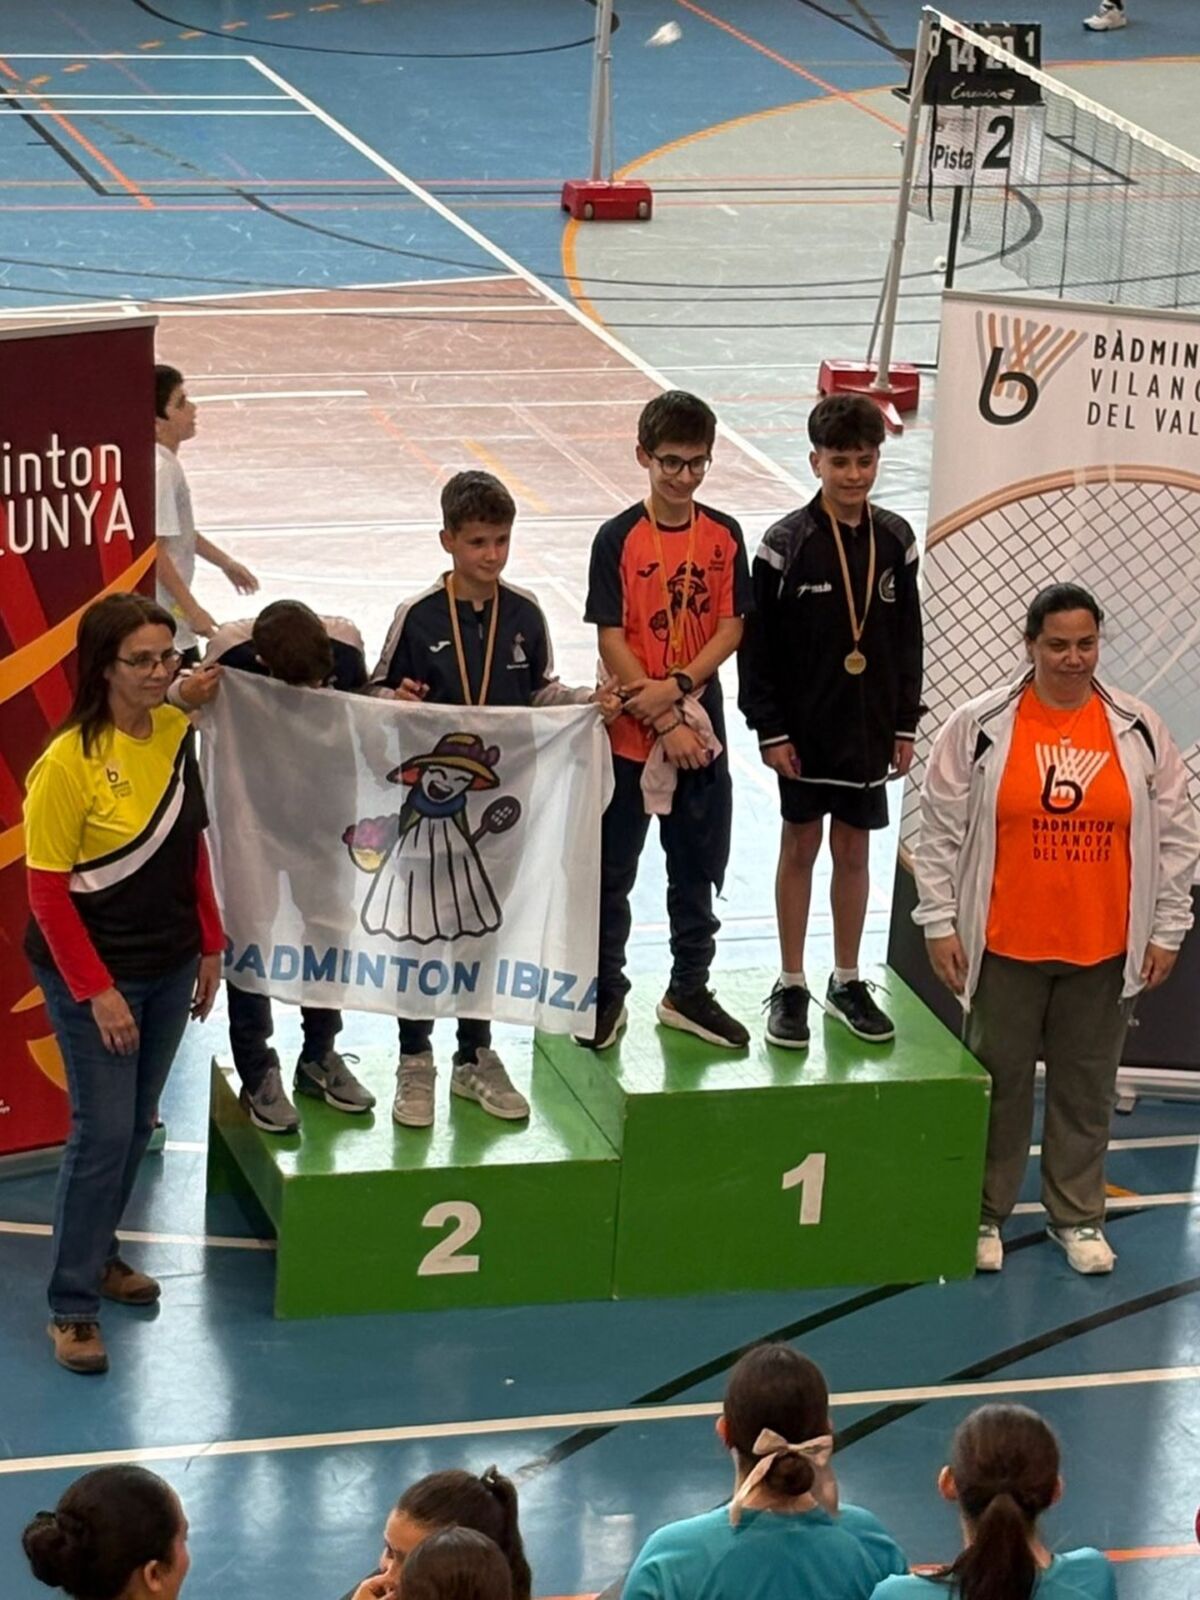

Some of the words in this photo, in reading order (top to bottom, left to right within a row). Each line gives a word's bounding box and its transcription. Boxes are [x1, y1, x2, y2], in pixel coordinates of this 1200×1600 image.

[946, 38, 977, 72] 14
[1025, 31, 1035, 57] 1
[933, 145, 974, 170] Pista
[982, 115, 1014, 169] 2
[1087, 401, 1135, 429] DEL
[1155, 407, 1199, 436] VAL
[3, 433, 121, 495] inton
[0, 487, 134, 555] UNYA
[1034, 847, 1057, 861] DEL
[782, 1152, 826, 1225] 1
[417, 1200, 482, 1276] 2
